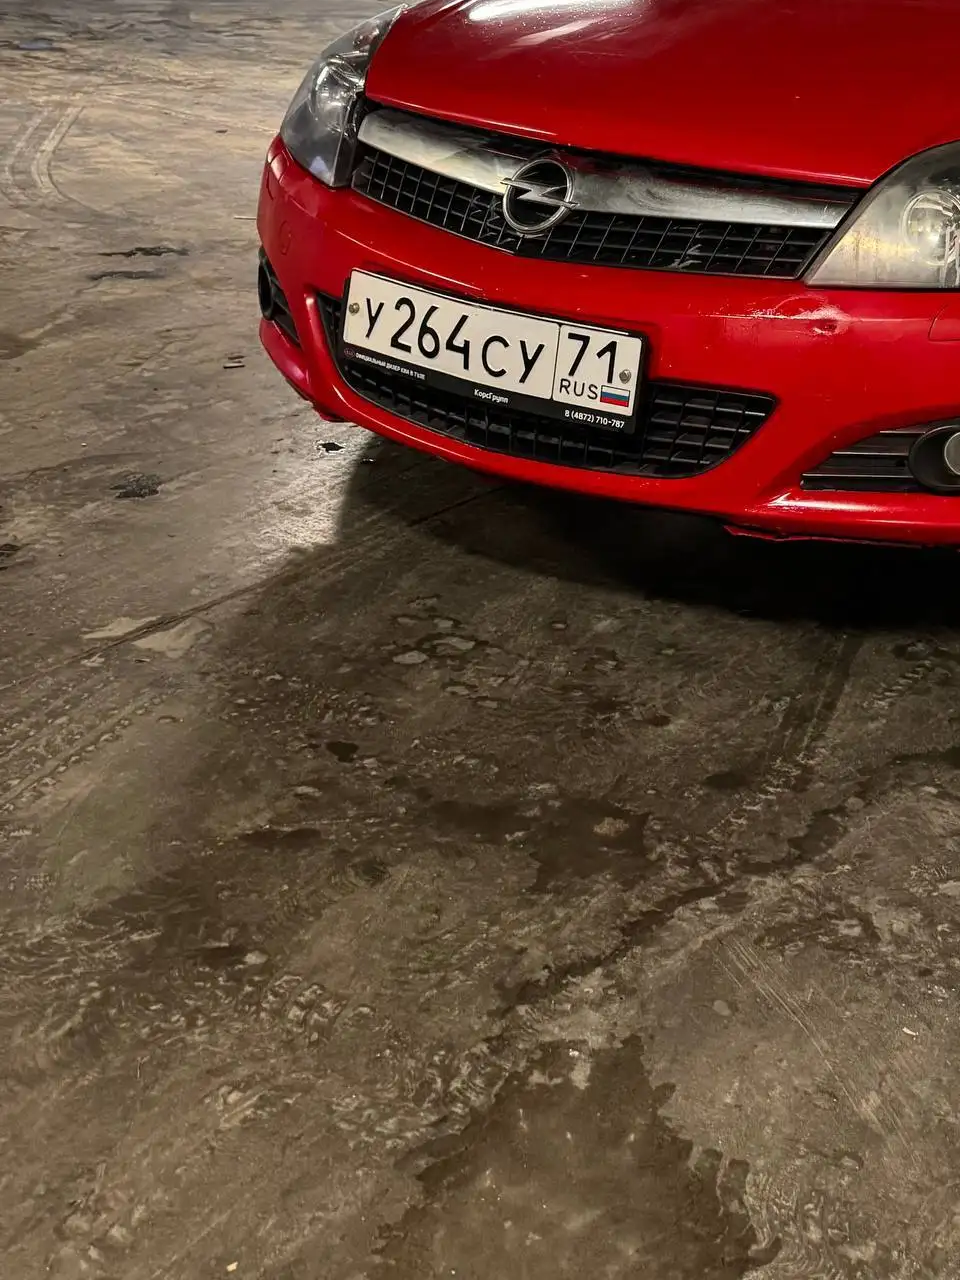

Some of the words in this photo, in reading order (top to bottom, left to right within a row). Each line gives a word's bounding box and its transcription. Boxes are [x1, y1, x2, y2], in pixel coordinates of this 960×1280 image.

[567, 333, 618, 384] 71
[559, 378, 599, 400] RUS
[595, 416, 625, 429] 710-787
